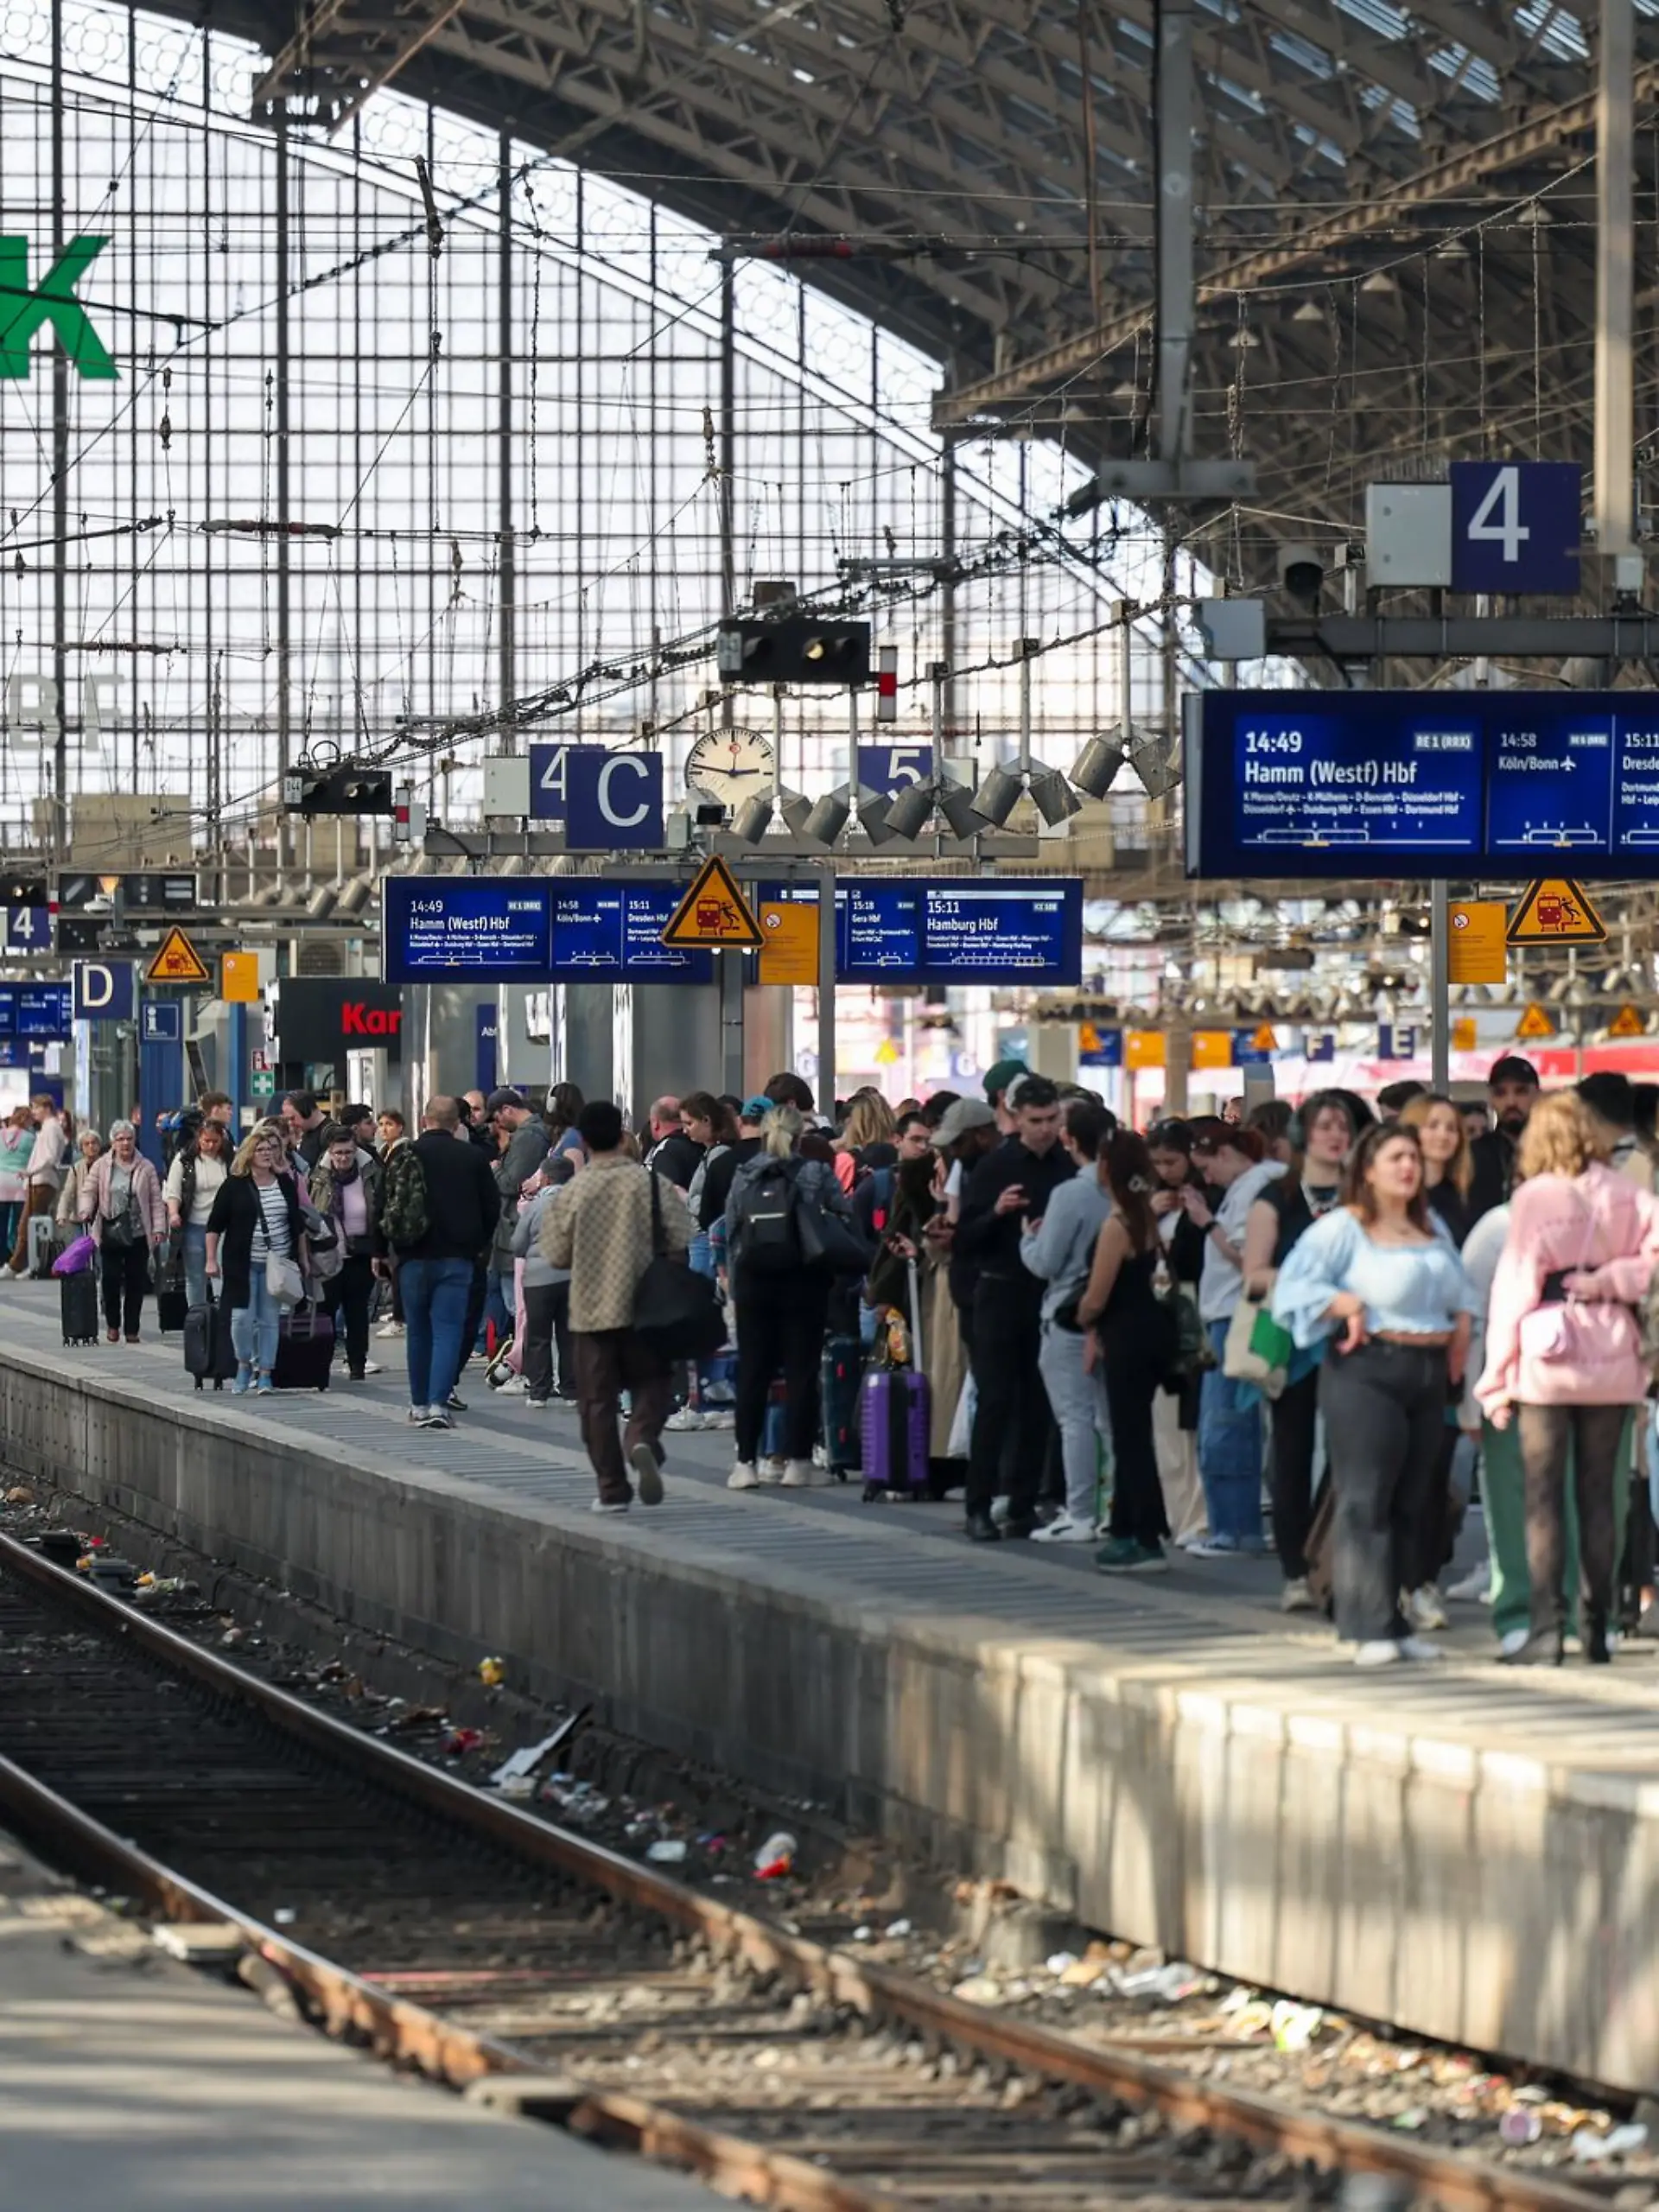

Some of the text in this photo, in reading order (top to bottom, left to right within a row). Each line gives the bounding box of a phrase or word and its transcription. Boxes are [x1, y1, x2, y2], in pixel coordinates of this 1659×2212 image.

[1467, 467, 1529, 562] 4
[1245, 732, 1302, 753] 14:49
[1501, 734, 1537, 747] 14:58
[1245, 760, 1418, 786] Hamm (Westf) Hbf
[1498, 755, 1559, 771] Köln/Bonn
[540, 747, 569, 801] 4
[598, 755, 650, 827] C
[410, 900, 443, 913] 14:49
[927, 901, 960, 913] 15:11
[13, 907, 35, 939] 4
[490, 917, 510, 930] Hbf
[926, 918, 999, 933] Hamburg Hbf
[82, 964, 113, 1007] D
